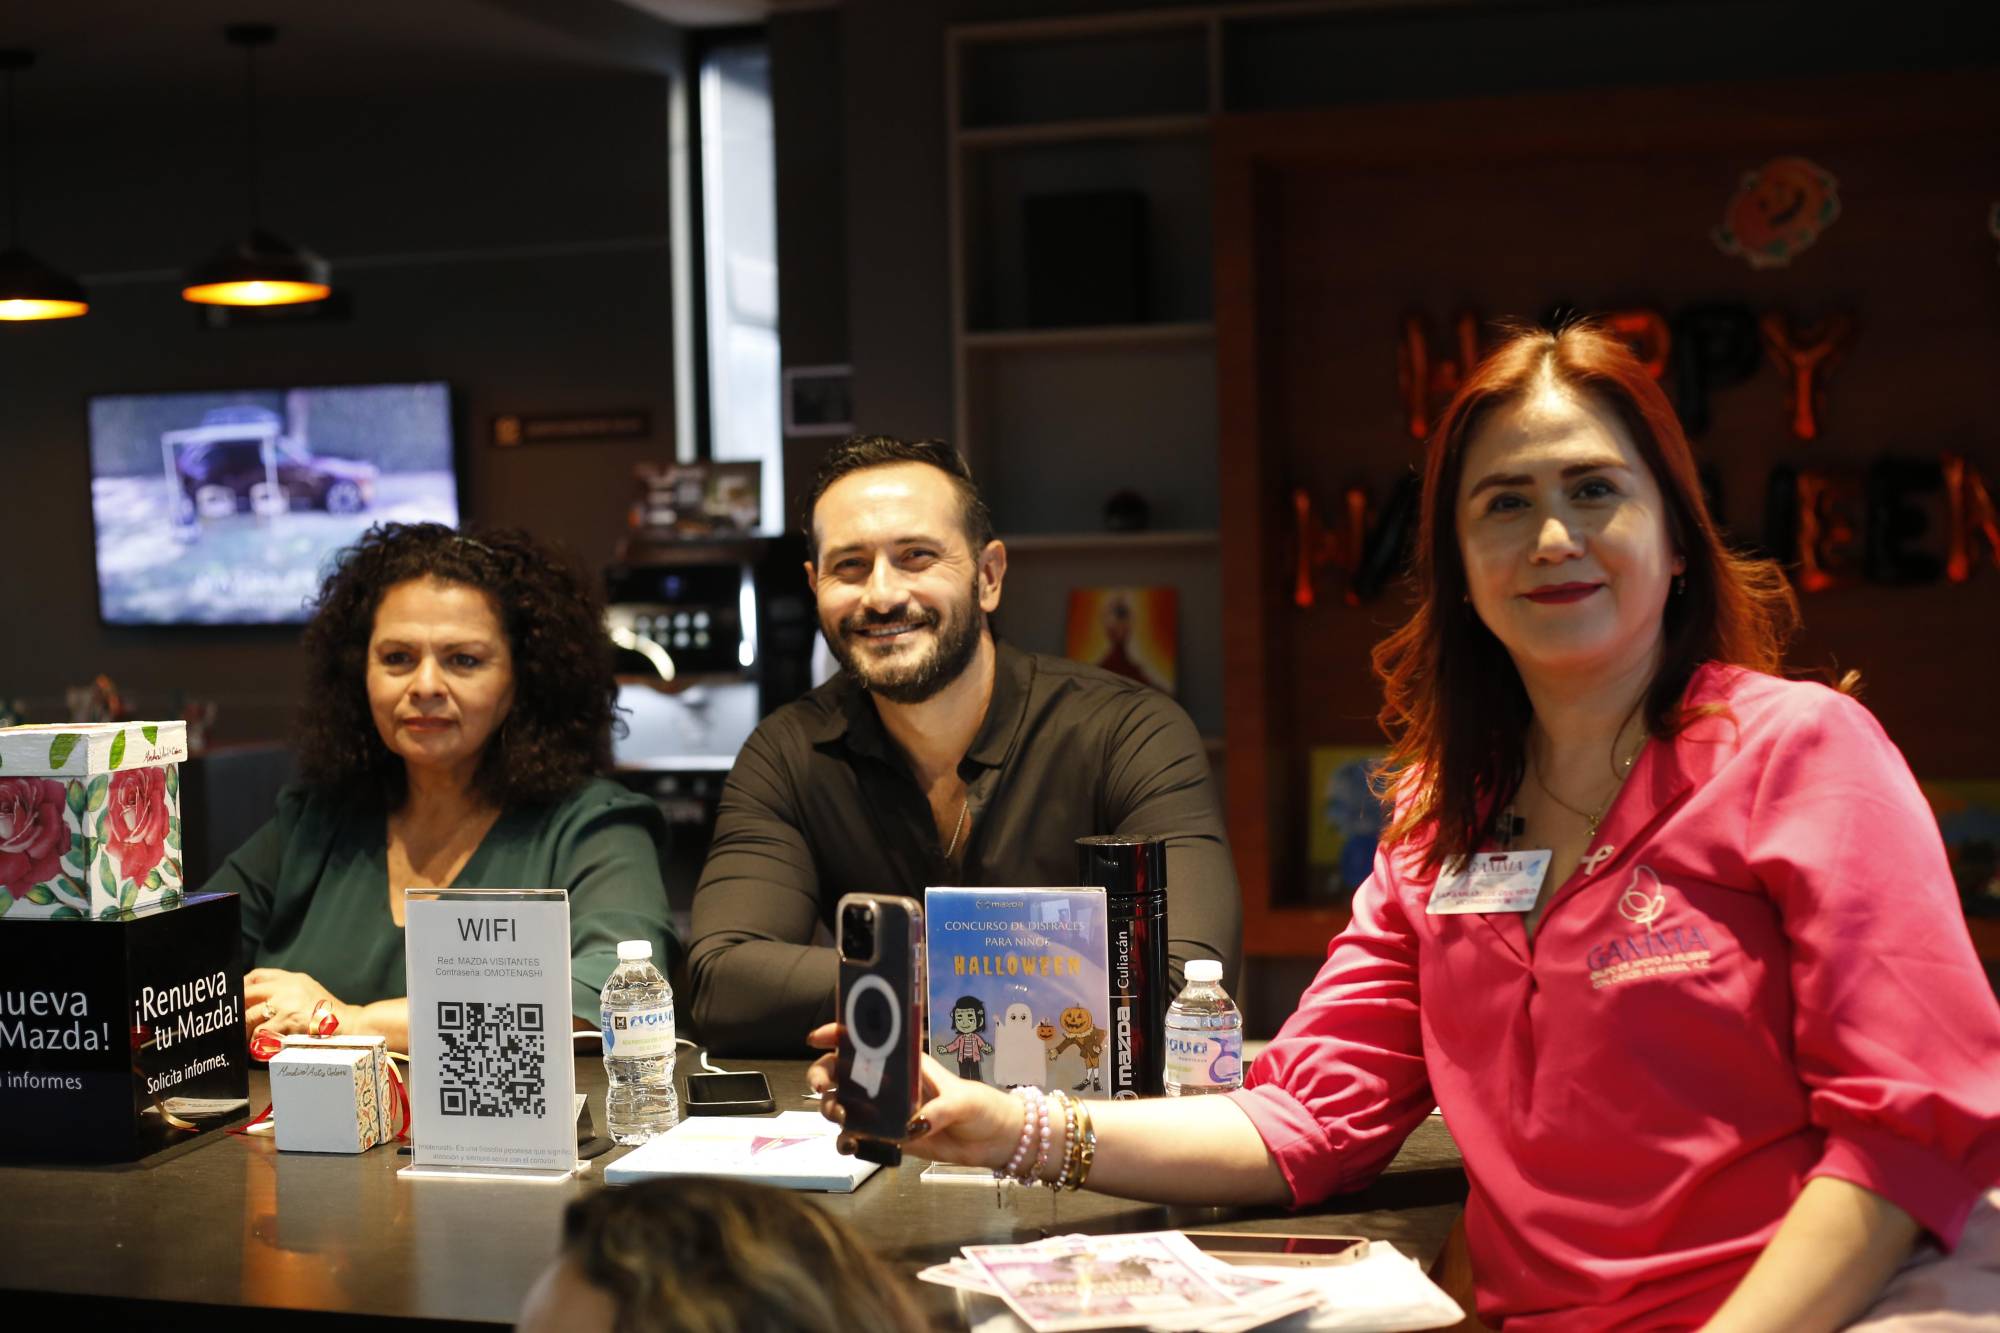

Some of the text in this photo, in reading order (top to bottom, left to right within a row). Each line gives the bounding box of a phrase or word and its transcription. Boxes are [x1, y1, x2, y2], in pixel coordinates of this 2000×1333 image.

[457, 917, 516, 942] WIFI
[944, 921, 1008, 931] CONCURSO
[985, 937, 1012, 947] PARA
[458, 957, 488, 966] MAZDA
[490, 957, 541, 967] VISITANTES
[954, 954, 1081, 977] HALLOWEEN
[1115, 931, 1129, 989] Culiacán
[484, 968, 543, 978] OMOTENASHI
[0, 991, 88, 1016] ueva
[135, 971, 227, 1034] ¡Renueva
[0, 1020, 109, 1051] Mazda!
[155, 995, 239, 1051] tu Mazda!
[7, 1071, 82, 1090] informes
[147, 1068, 182, 1095] Solicita
